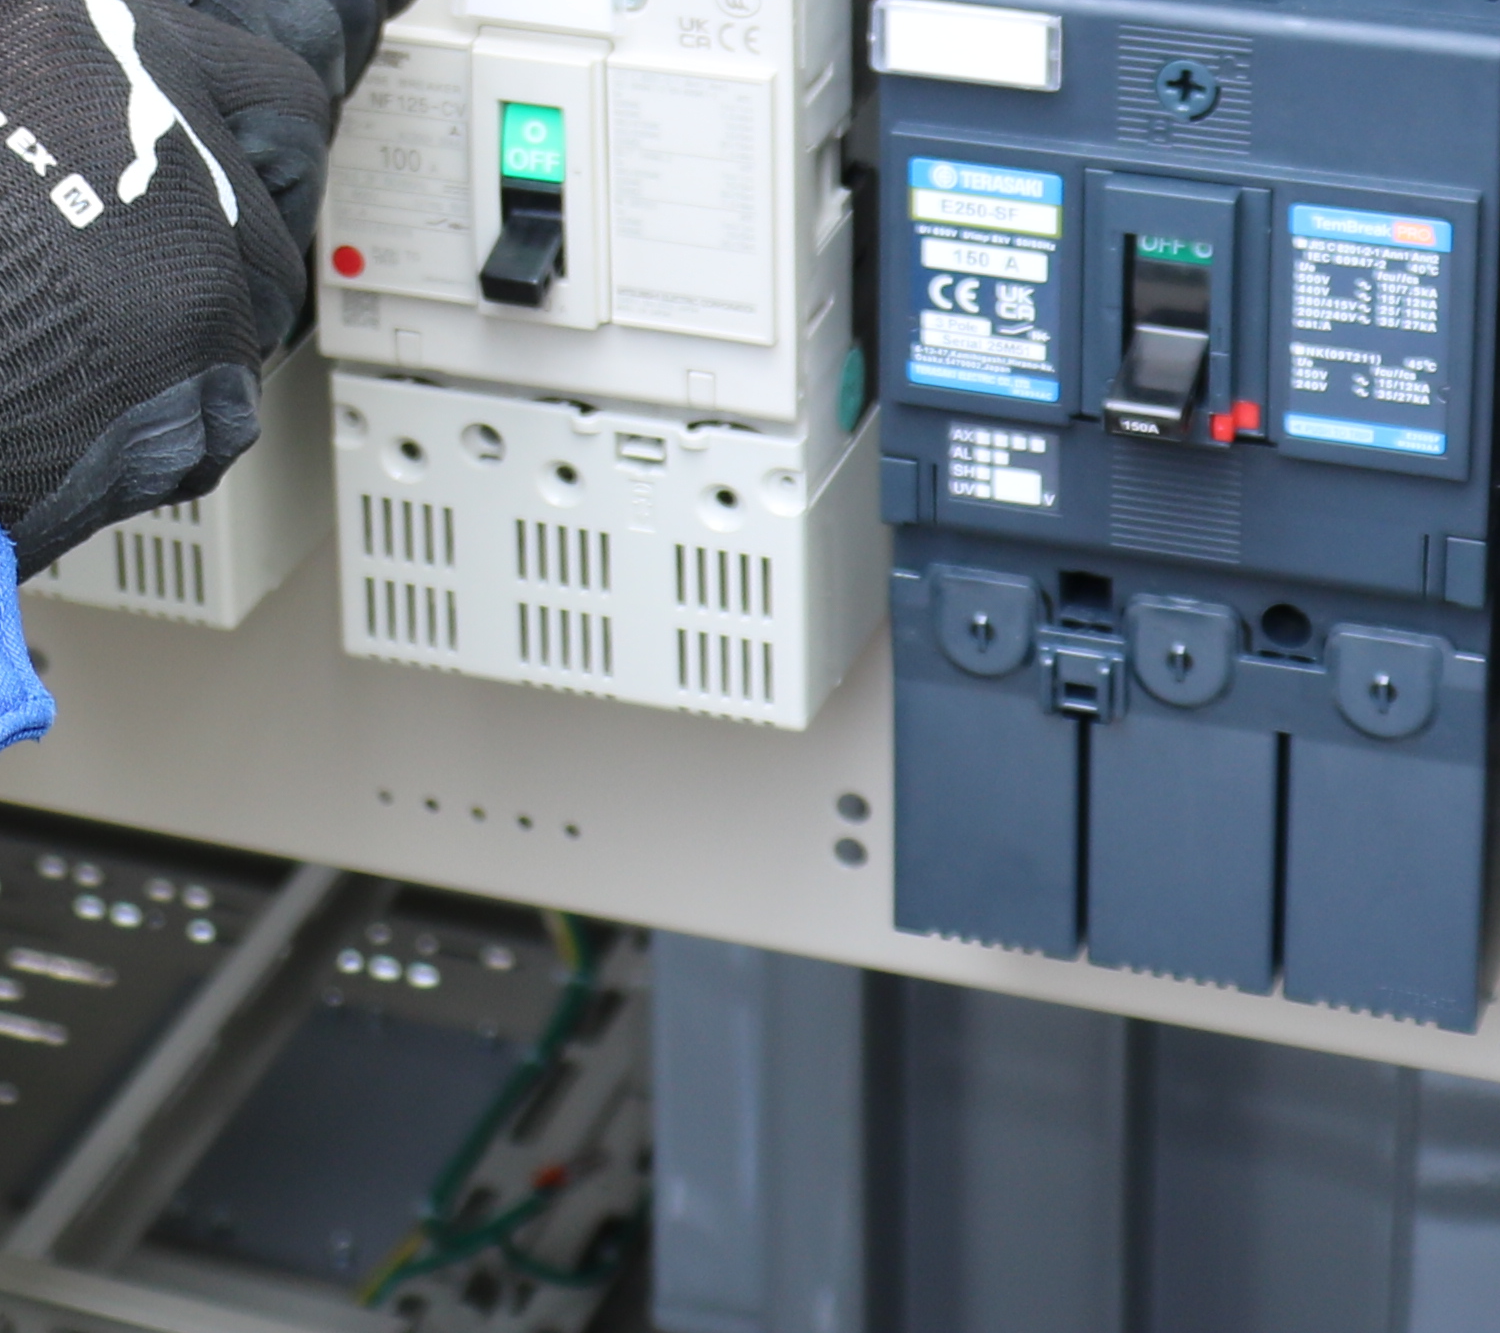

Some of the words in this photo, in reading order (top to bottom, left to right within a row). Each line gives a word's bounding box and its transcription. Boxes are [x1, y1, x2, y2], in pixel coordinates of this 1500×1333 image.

[6, 126, 58, 177] EX
[379, 145, 422, 173] 100
[507, 147, 562, 173] OFF
[960, 170, 1043, 198] TERASAKI
[941, 198, 1019, 222] E250-SF
[1313, 215, 1392, 238] TemBreak
[1396, 226, 1432, 242] PRO
[953, 248, 990, 268] 150
[1004, 255, 1020, 273] A
[952, 429, 975, 443] AX
[1122, 419, 1160, 435] 150A
[952, 447, 973, 461] AL
[953, 464, 975, 479] SH
[953, 481, 975, 496] UV
[1043, 493, 1056, 507] V
